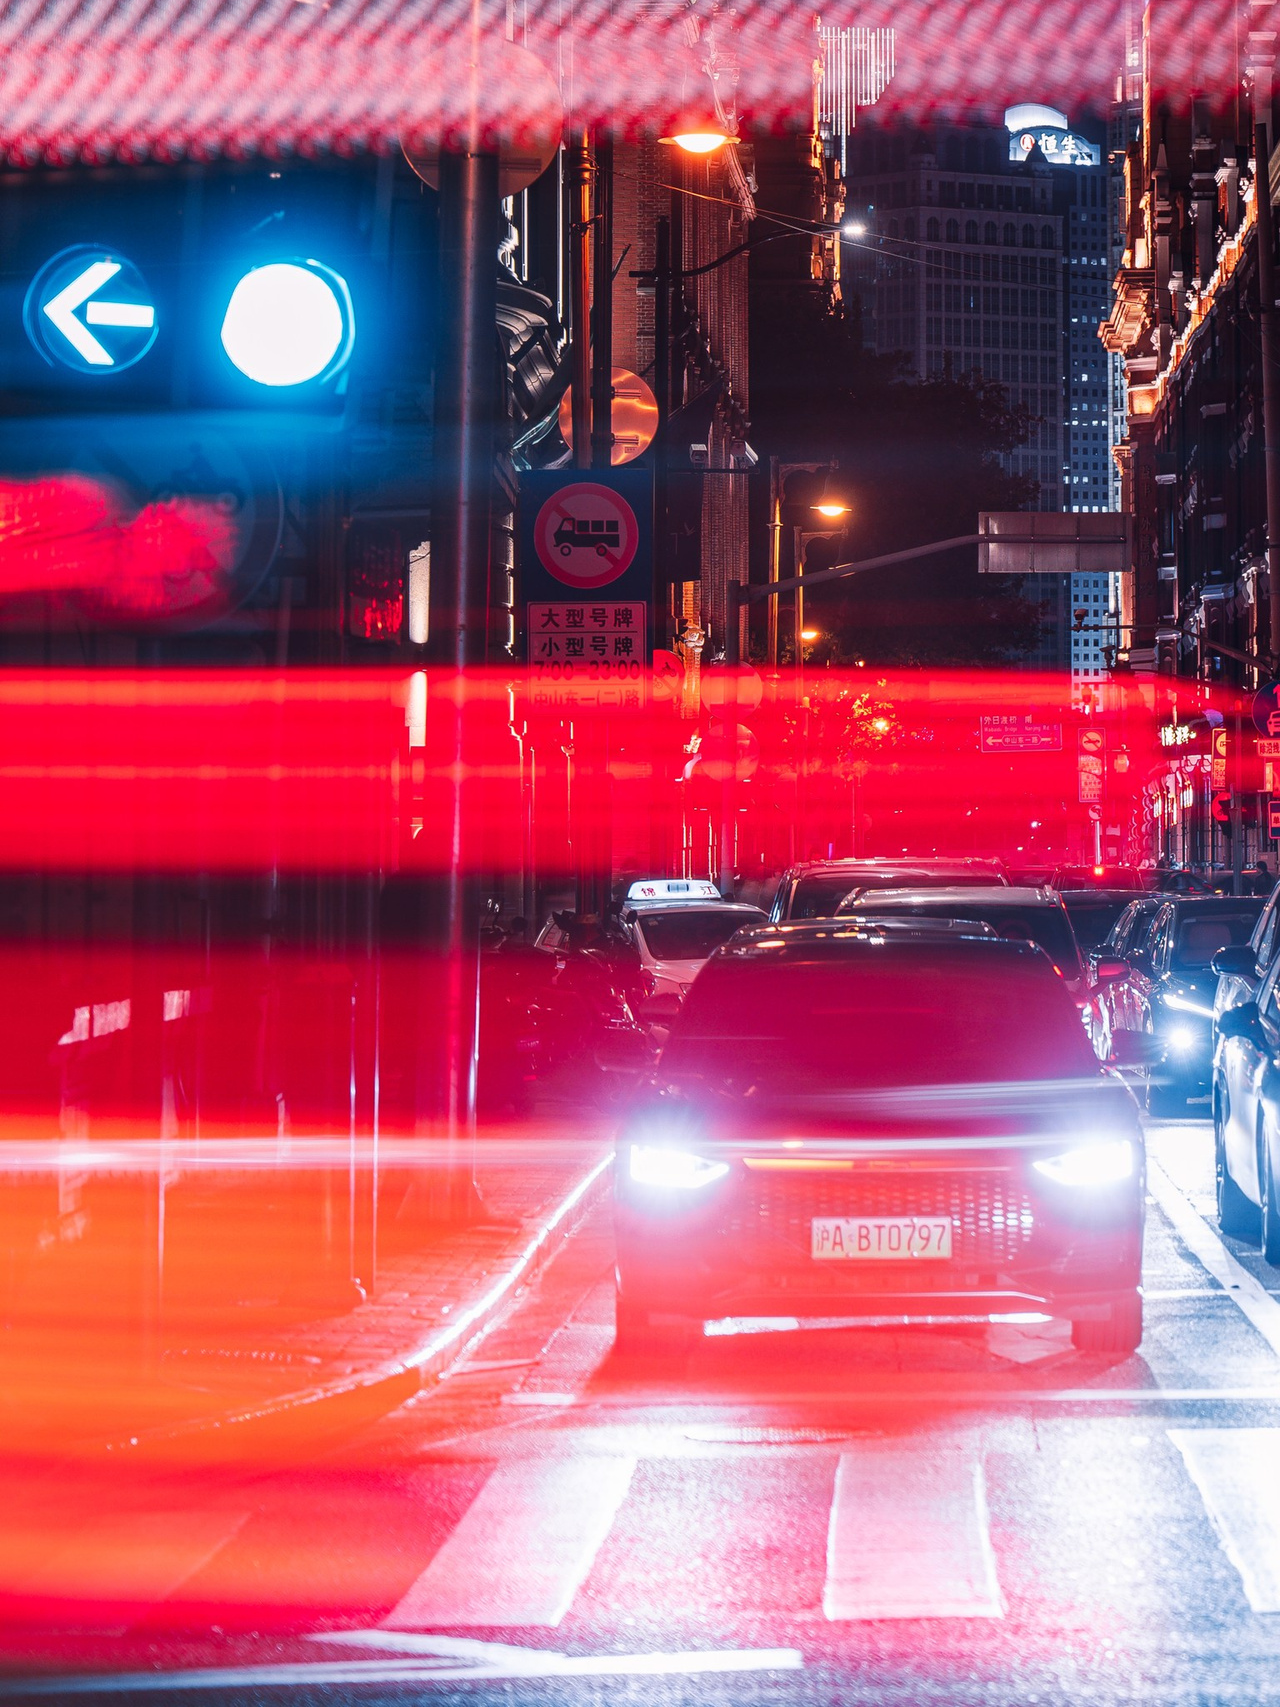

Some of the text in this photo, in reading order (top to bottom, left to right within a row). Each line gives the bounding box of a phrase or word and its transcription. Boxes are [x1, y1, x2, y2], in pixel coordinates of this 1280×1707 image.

[1038, 133, 1077, 154] 恒生
[541, 608, 634, 628] 大型号牌
[541, 635, 634, 657] 小型号牌
[1004, 735, 1039, 744] 中山东一路
